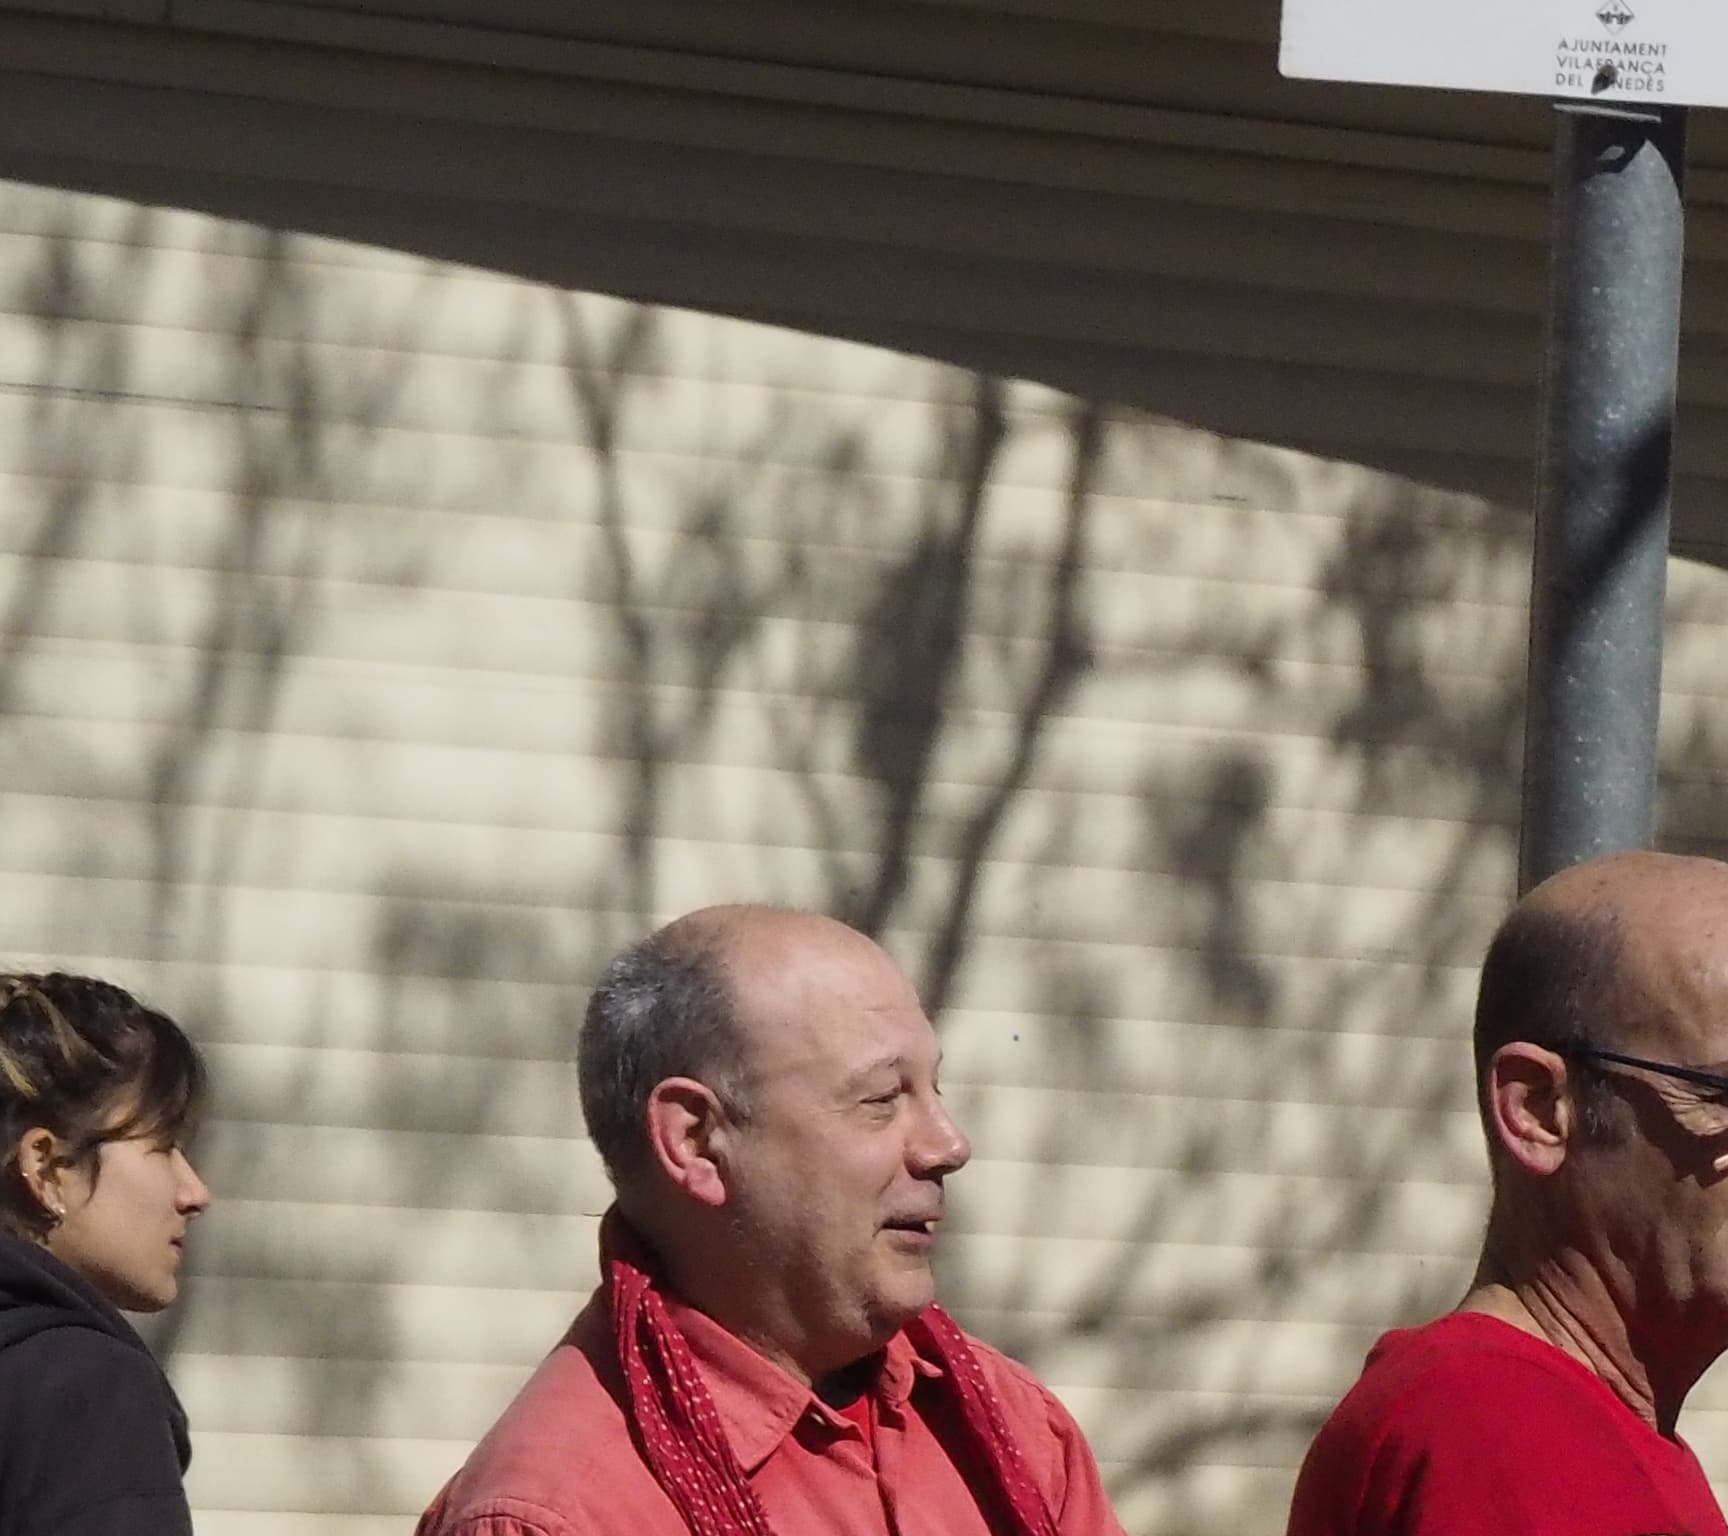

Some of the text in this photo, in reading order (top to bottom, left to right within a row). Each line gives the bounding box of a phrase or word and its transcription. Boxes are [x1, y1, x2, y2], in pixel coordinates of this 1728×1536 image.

[1558, 38, 1667, 57] AJUNTAMENT
[1556, 73, 1665, 92] DEL NEDÈS
